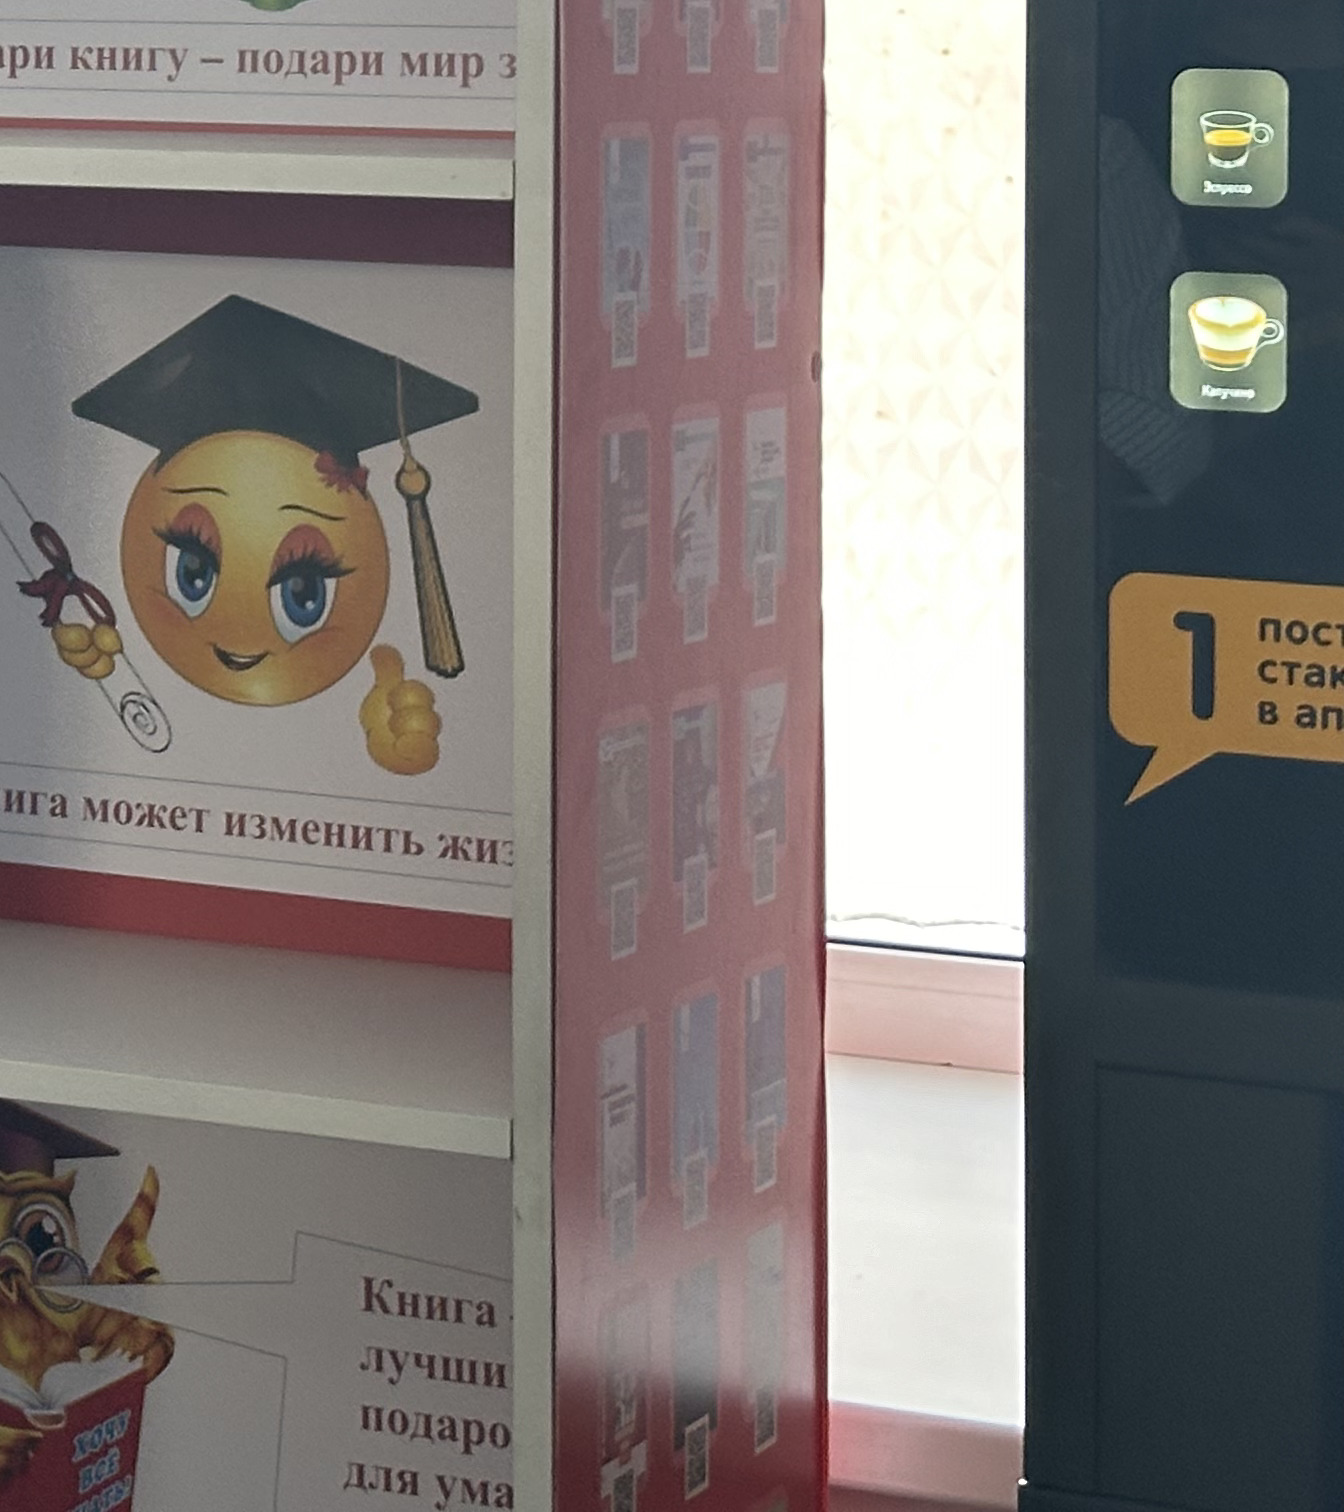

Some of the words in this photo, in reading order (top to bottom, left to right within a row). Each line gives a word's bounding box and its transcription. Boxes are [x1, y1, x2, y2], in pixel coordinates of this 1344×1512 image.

[68, 44, 189, 83] книгу
[237, 46, 385, 86] подари
[399, 49, 485, 89] мир
[499, 52, 516, 80] з
[1173, 611, 1216, 720] 1
[1258, 701, 1279, 726] в
[1295, 703, 1344, 731] ап
[83, 800, 210, 836] может
[224, 809, 425, 857] изменить
[361, 1276, 497, 1329] Книга
[360, 1346, 508, 1389] лучши
[72, 1409, 132, 1463] ХОЧУ
[361, 1404, 513, 1456] подаро
[343, 1461, 420, 1498] для
[435, 1473, 514, 1511] ума
